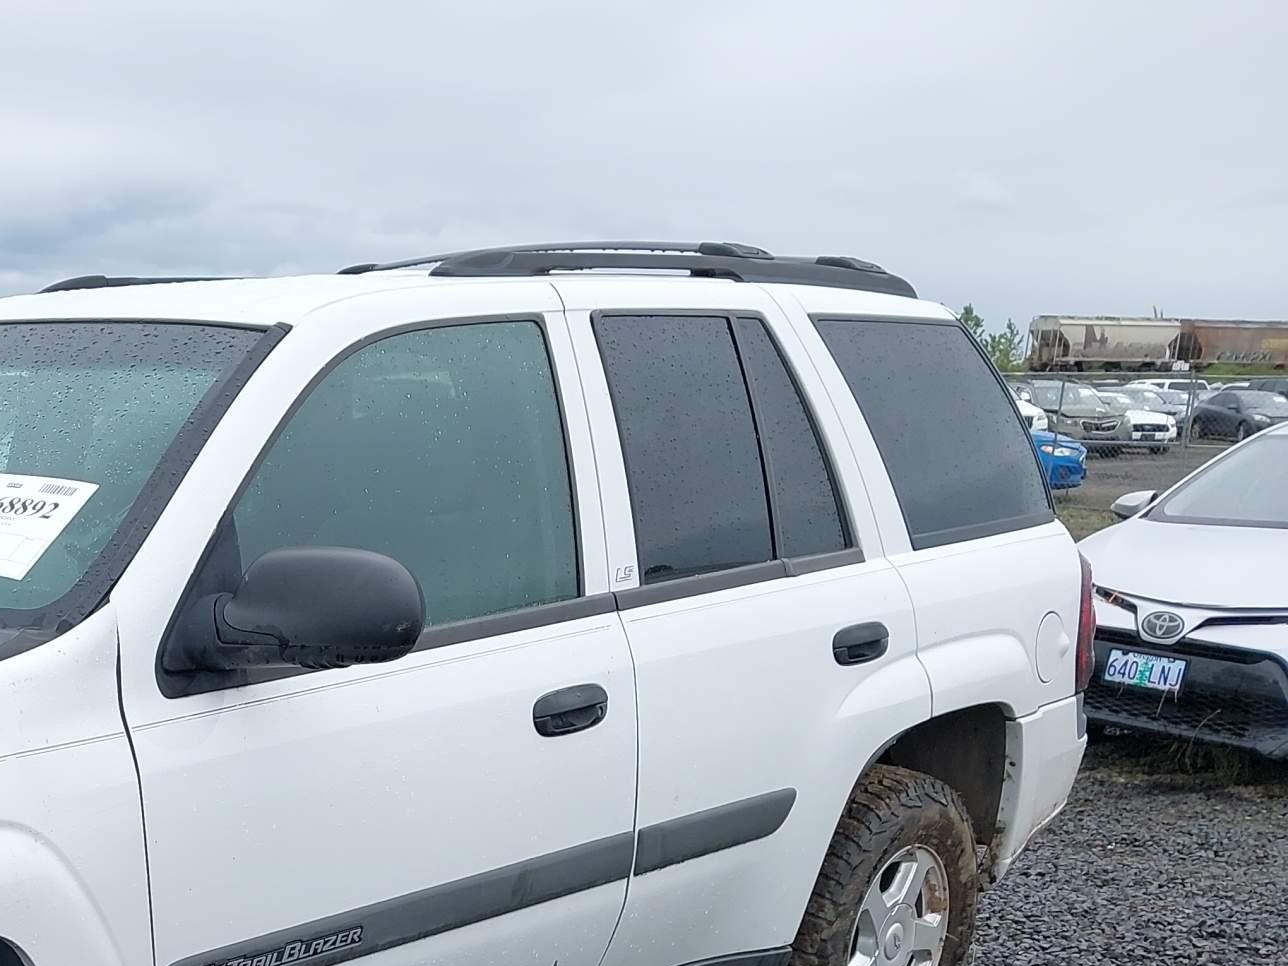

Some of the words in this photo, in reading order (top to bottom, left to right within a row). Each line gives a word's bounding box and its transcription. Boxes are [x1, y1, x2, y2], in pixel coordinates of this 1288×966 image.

[615, 565, 634, 583] LS
[1107, 658, 1139, 680] 640
[1147, 664, 1182, 687] LNJ
